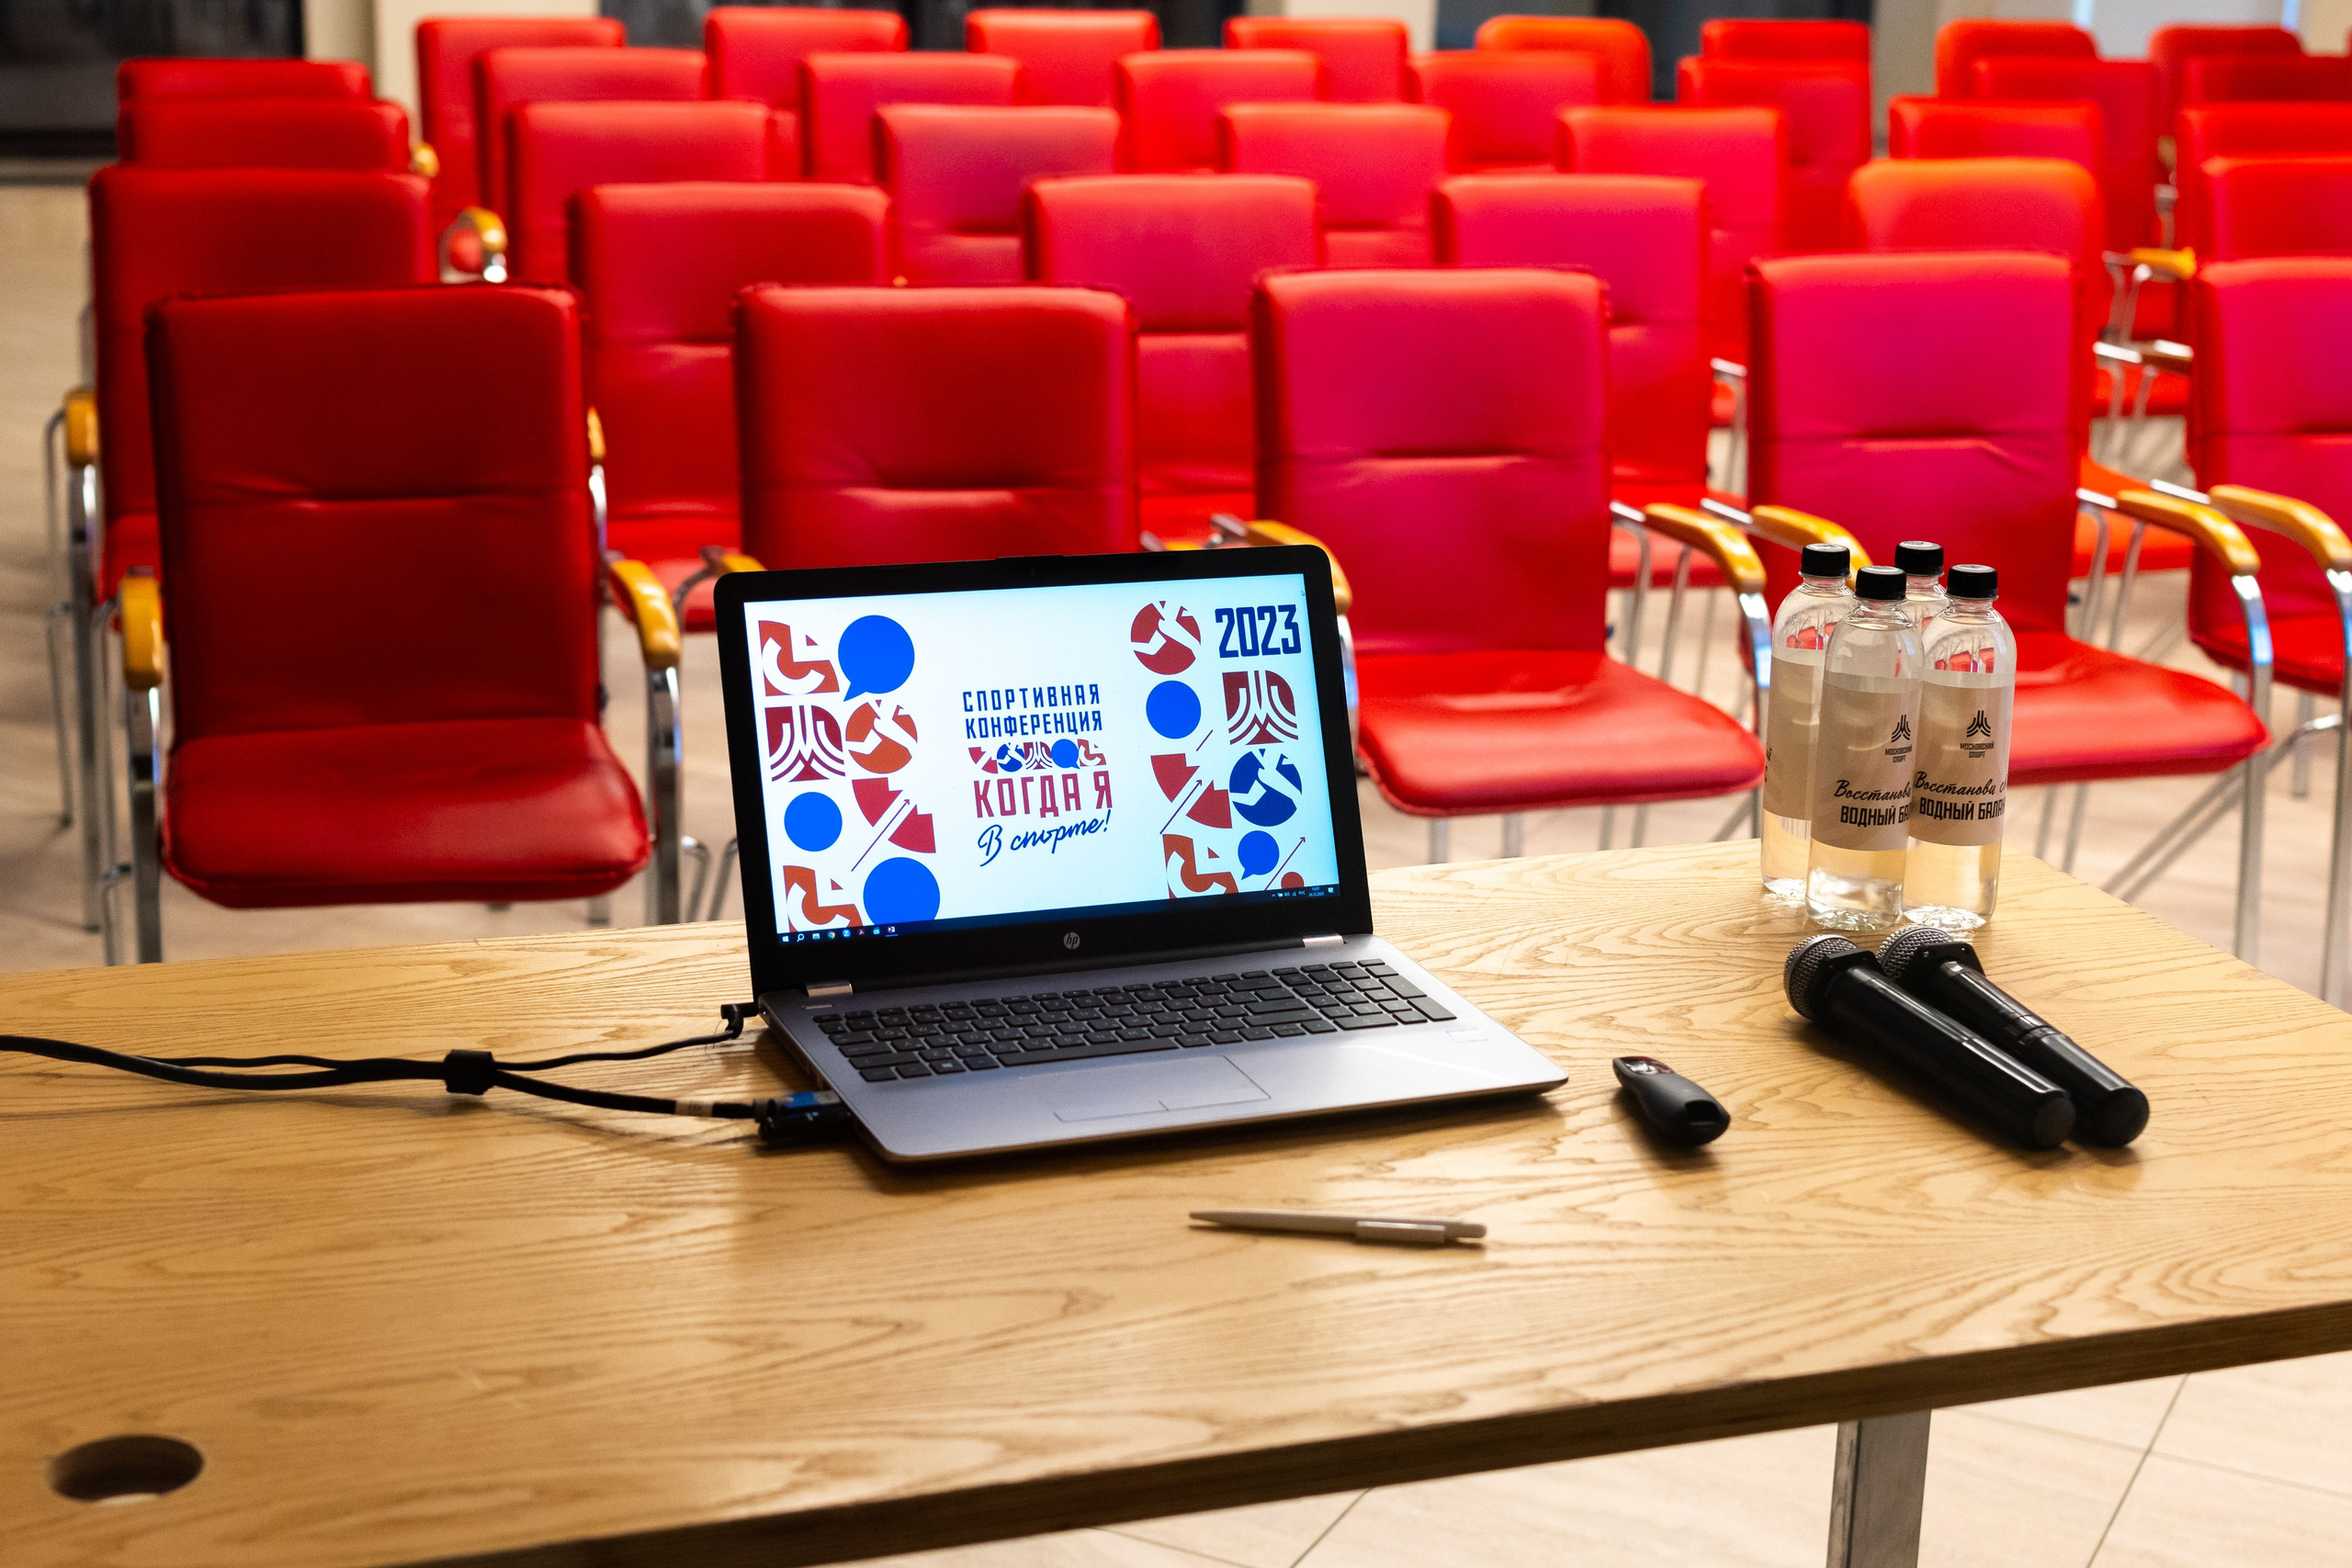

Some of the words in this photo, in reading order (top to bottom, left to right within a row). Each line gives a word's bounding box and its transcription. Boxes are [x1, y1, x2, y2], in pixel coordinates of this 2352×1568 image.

[1215, 604, 1302, 659] 2023
[963, 683, 1101, 713] СПОРТИВНАЯ
[965, 710, 1102, 739] КОНФЕРЕНЦИЯ
[974, 773, 1082, 818] КОГДА
[1092, 770, 1113, 809] Я
[1914, 771, 1996, 796] Восстанови
[1840, 805, 1896, 828] ВОДНЫЙ
[1919, 796, 1975, 821] ВОДНЫЙ
[978, 824, 1003, 867] В
[1010, 808, 1112, 855] спорте!
[1065, 931, 1080, 950] hp
